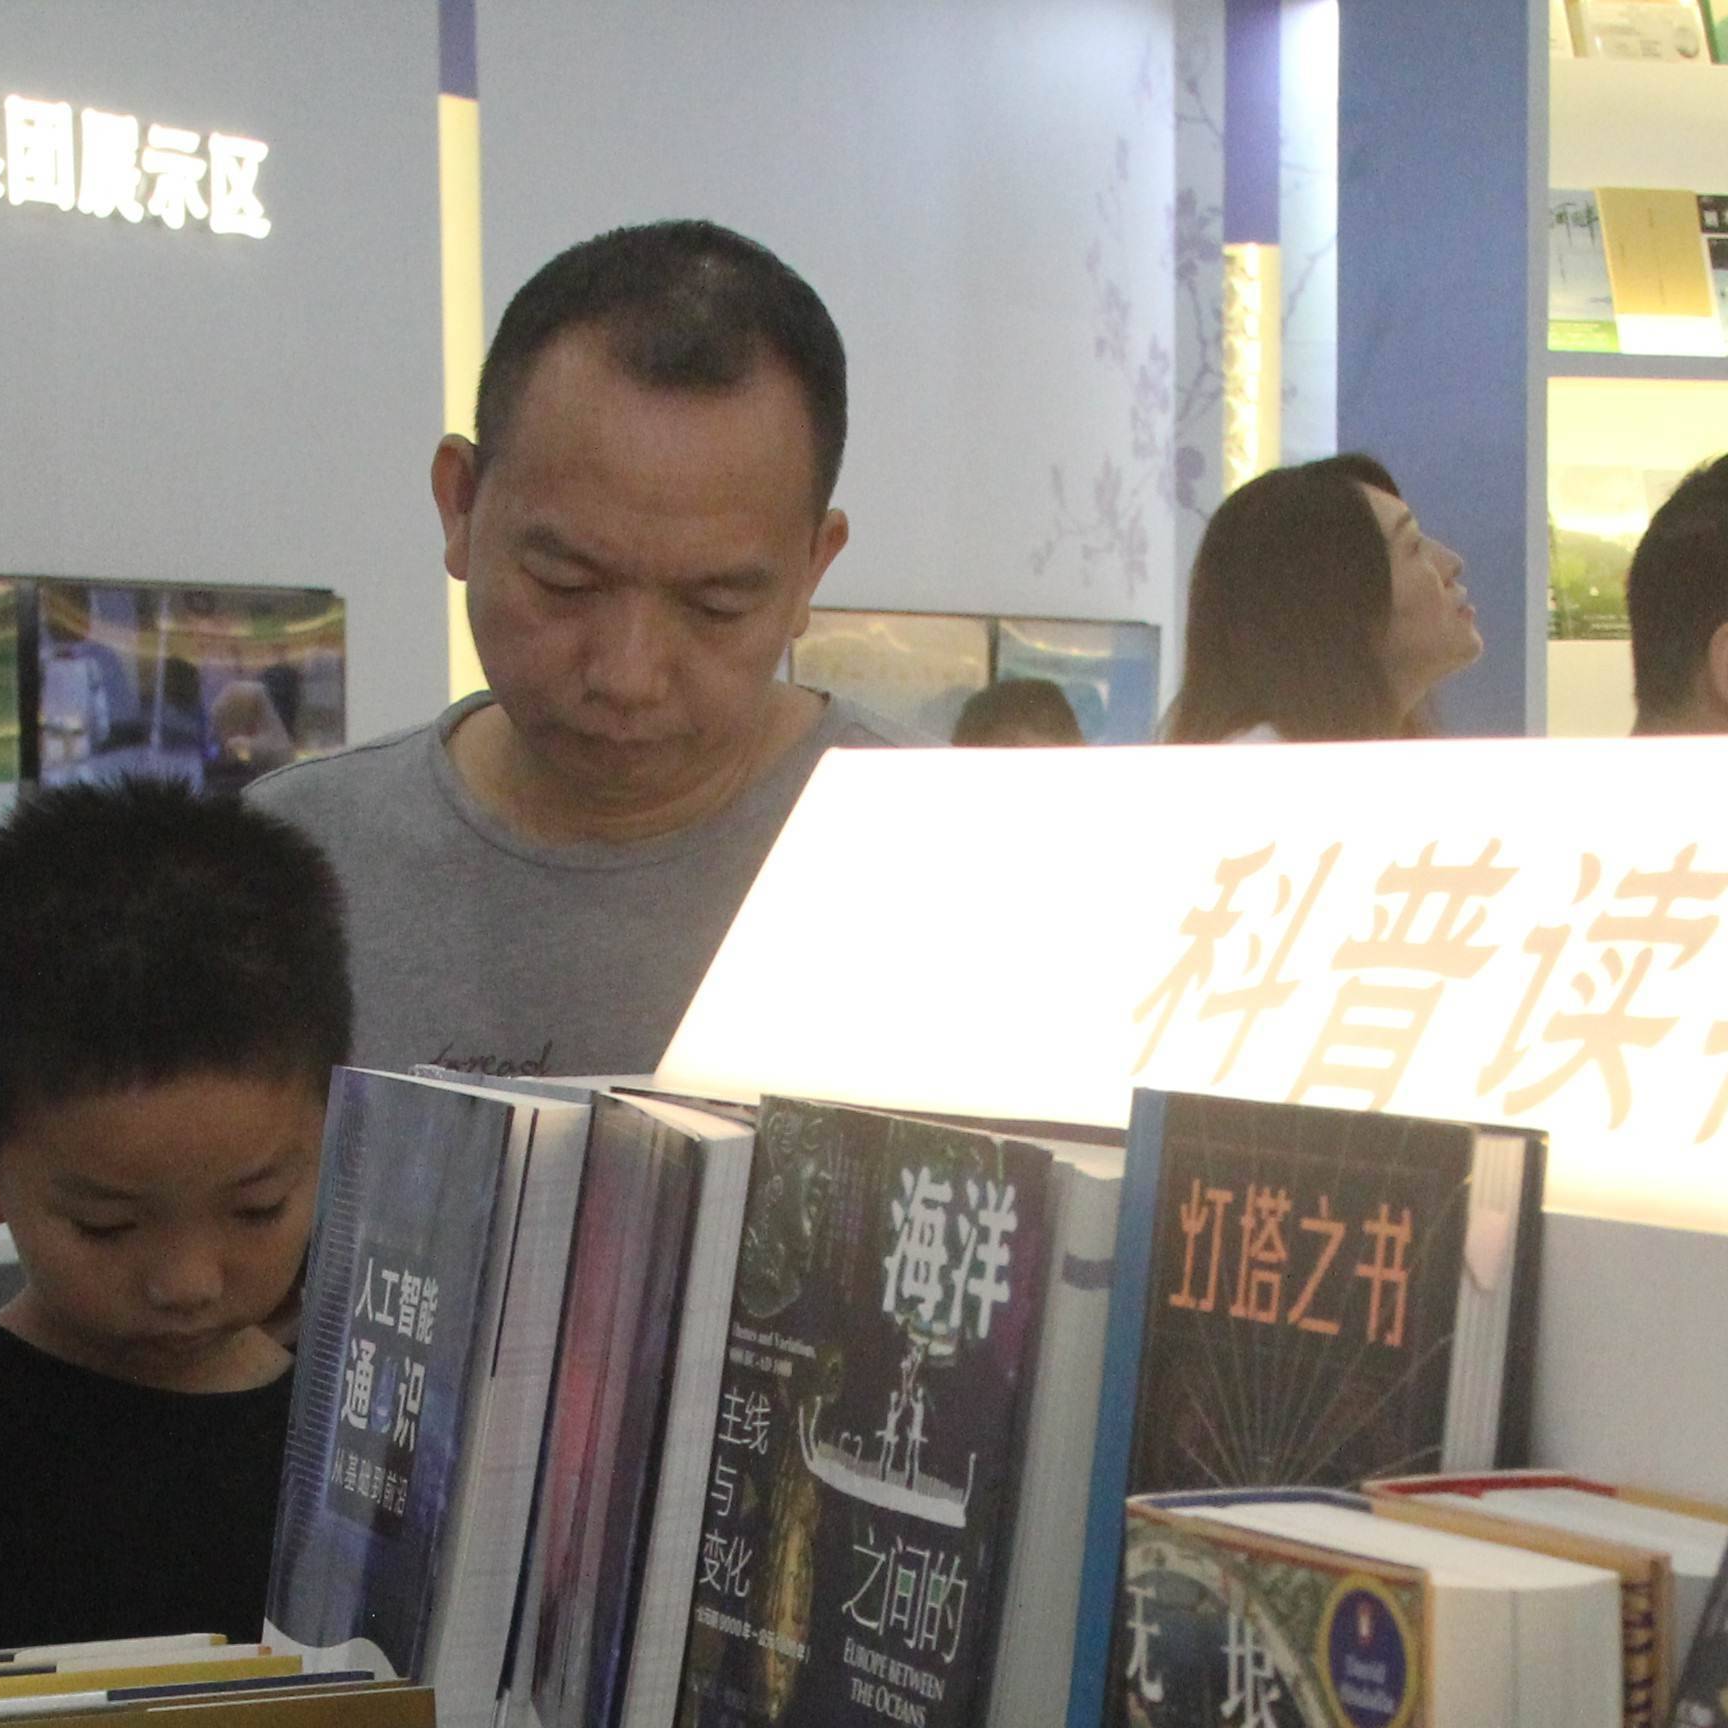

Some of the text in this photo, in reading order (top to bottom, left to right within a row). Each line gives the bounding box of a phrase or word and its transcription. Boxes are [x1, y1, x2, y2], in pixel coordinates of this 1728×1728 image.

[881, 1165, 1018, 1340] 海洋
[1170, 1177, 1413, 1349] 灯塔之书
[354, 1257, 439, 1345] 人工智能
[340, 1337, 426, 1452] 通识
[717, 1385, 772, 1455] 主线
[712, 1456, 738, 1516] 与
[698, 1527, 753, 1599] 变化
[842, 1525, 969, 1665] 之间的
[844, 1636, 946, 1701] EUROPE BETWEEN
[851, 1677, 874, 1708] THE
